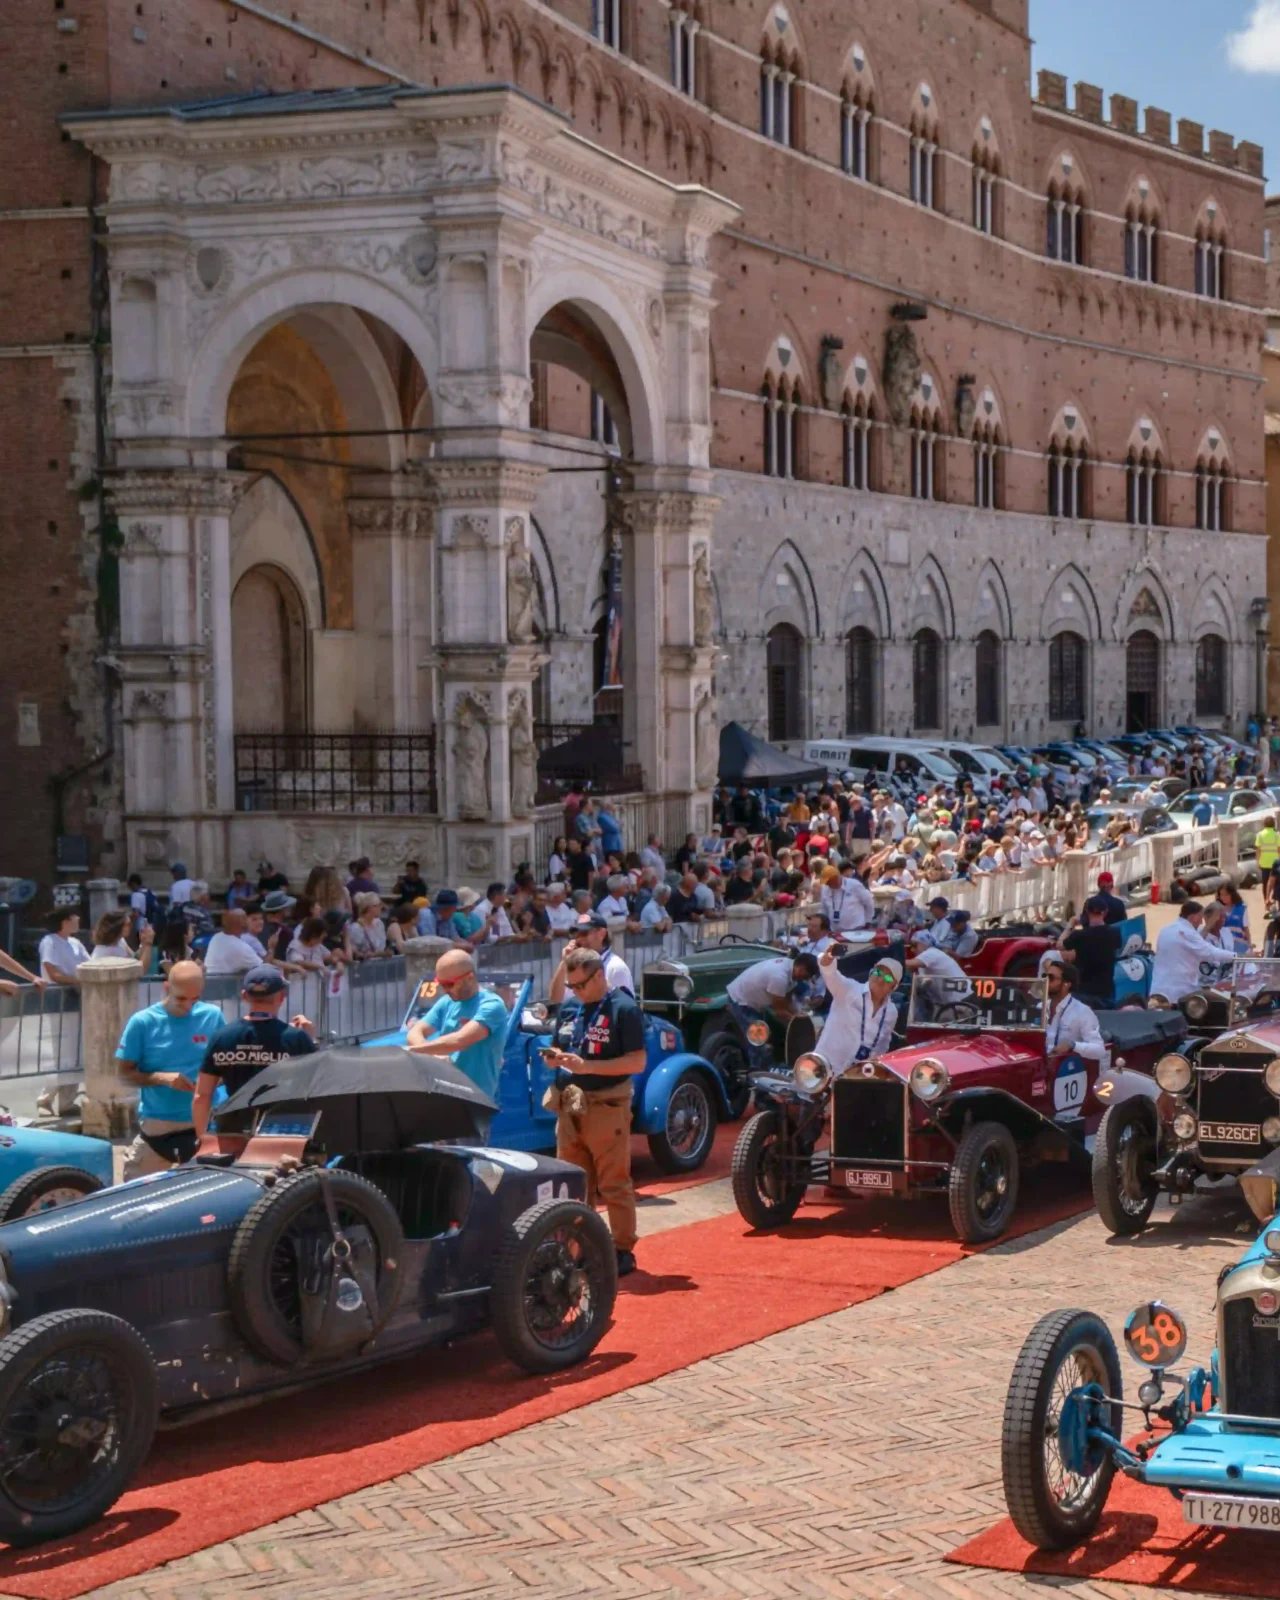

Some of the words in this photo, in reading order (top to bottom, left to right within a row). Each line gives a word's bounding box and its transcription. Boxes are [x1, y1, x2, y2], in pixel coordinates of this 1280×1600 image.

[420, 981, 437, 997] 13
[975, 980, 995, 998] 10
[212, 1051, 246, 1062] 1000
[1064, 1080, 1079, 1102] 10
[1097, 1082, 1114, 1097] 2
[1200, 1125, 1258, 1141] EL926CF
[1130, 1312, 1181, 1361] 38
